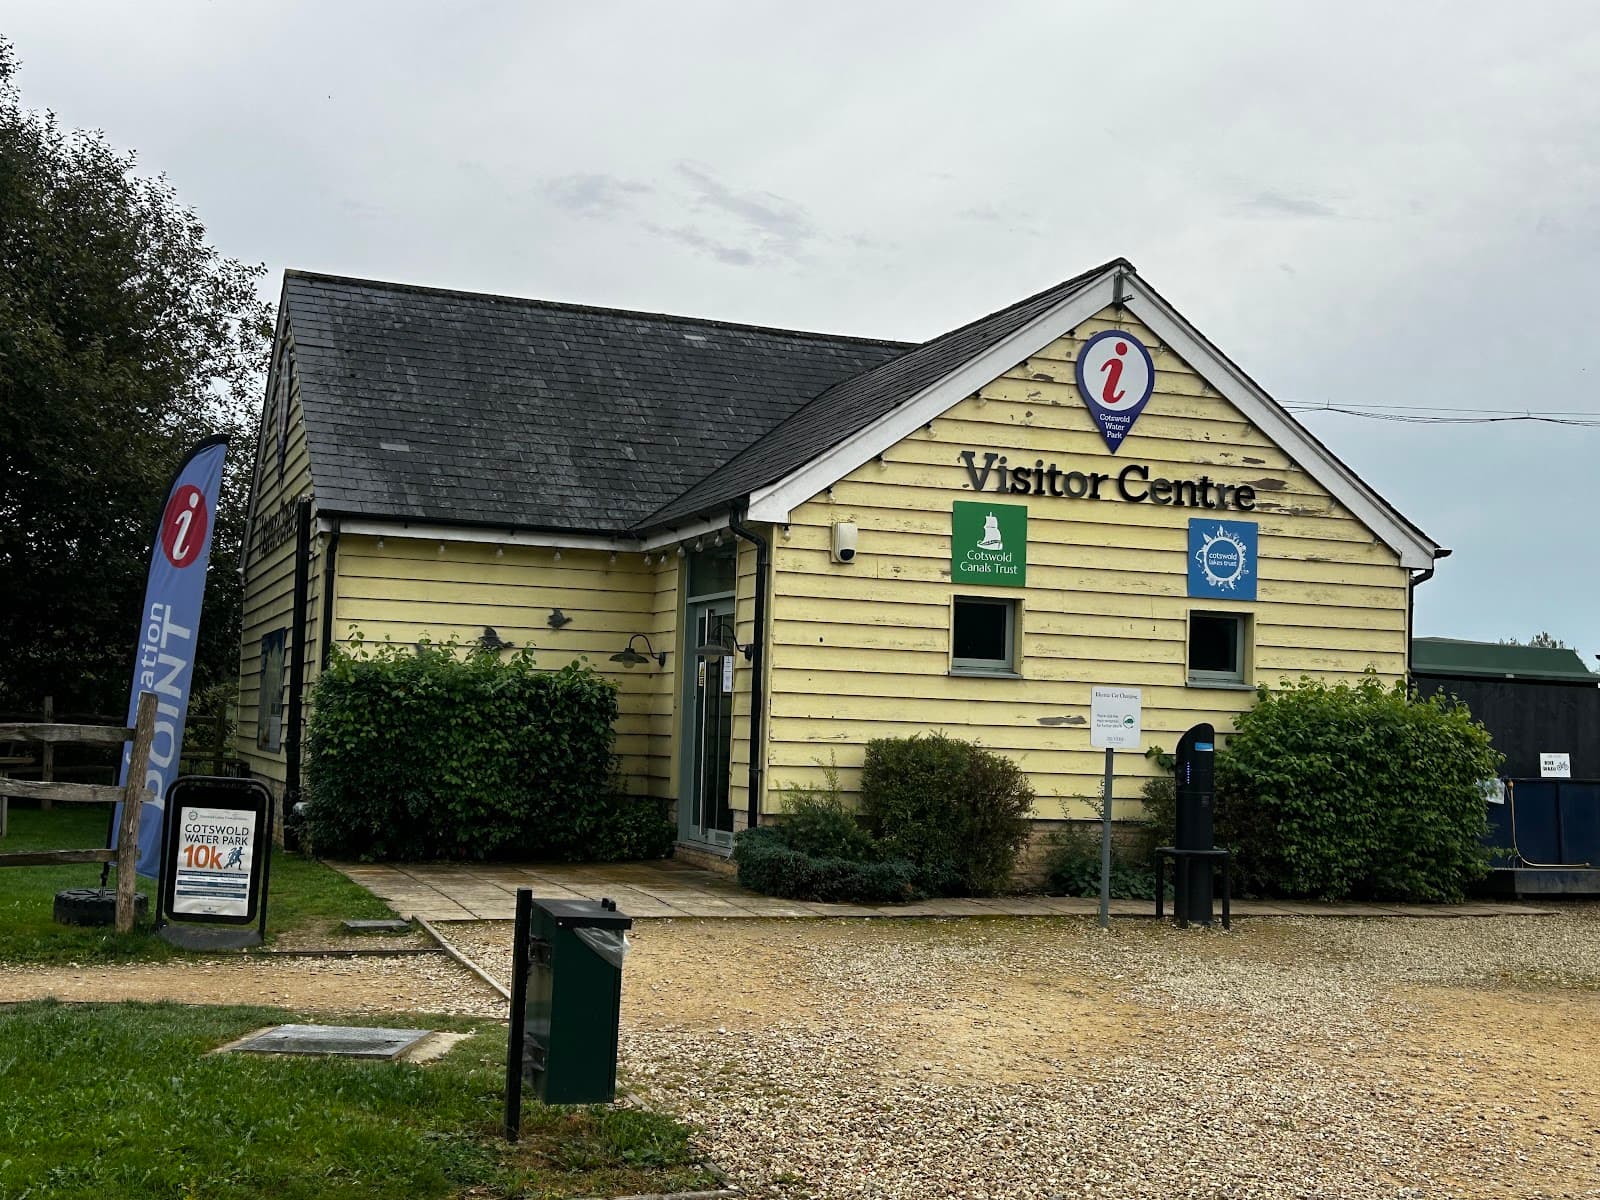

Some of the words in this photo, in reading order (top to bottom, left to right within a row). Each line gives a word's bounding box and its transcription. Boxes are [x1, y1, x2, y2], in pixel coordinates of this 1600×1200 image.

[1099, 413, 1130, 423] Cotswold
[1104, 422, 1125, 431] Water
[1107, 431, 1123, 439] Park
[960, 450, 1109, 499] Visitor
[1118, 464, 1256, 511] Centre
[966, 550, 1012, 562] Cotswold
[1208, 552, 1238, 560] cotswold
[959, 561, 992, 573] Canals
[994, 563, 1018, 575] Trust
[144, 604, 191, 811] POINT
[184, 823, 249, 836] COTSWOLD
[184, 833, 219, 845] WATER
[222, 836, 249, 846] PARK
[183, 844, 224, 870] 10k
